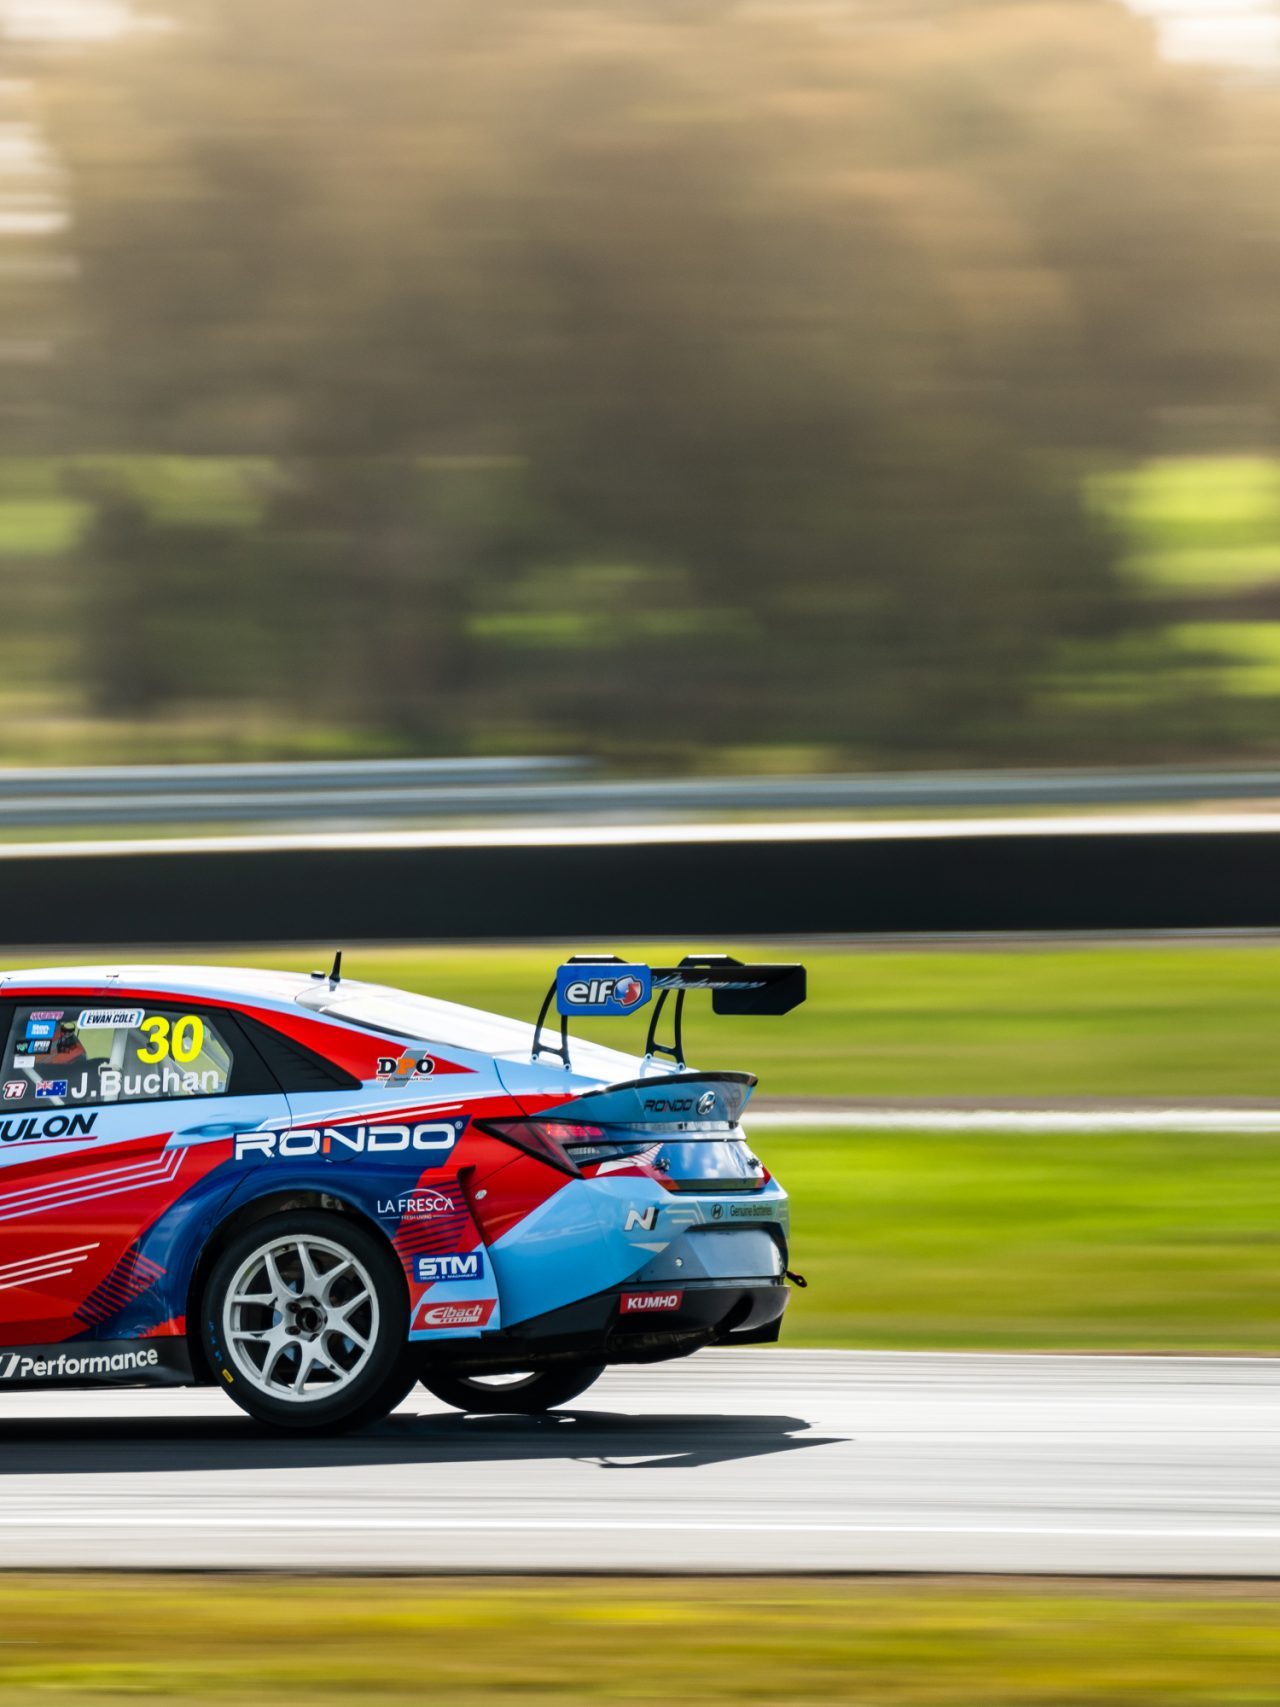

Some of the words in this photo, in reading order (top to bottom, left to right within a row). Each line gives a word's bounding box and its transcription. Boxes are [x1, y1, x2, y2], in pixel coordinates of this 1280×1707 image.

[567, 980, 613, 1004] elf
[87, 1014, 112, 1024] EWAN
[113, 1014, 135, 1023] COLE
[136, 1015, 204, 1064] 30
[71, 1067, 219, 1099] J.Buchan
[644, 1099, 693, 1113] RONDO
[377, 1199, 395, 1213] LA
[398, 1198, 455, 1213] FRESCA
[418, 1255, 478, 1277] STM
[627, 1295, 678, 1310] KUMHO
[424, 1305, 483, 1325] Eibach
[20, 1348, 159, 1378] Performance
